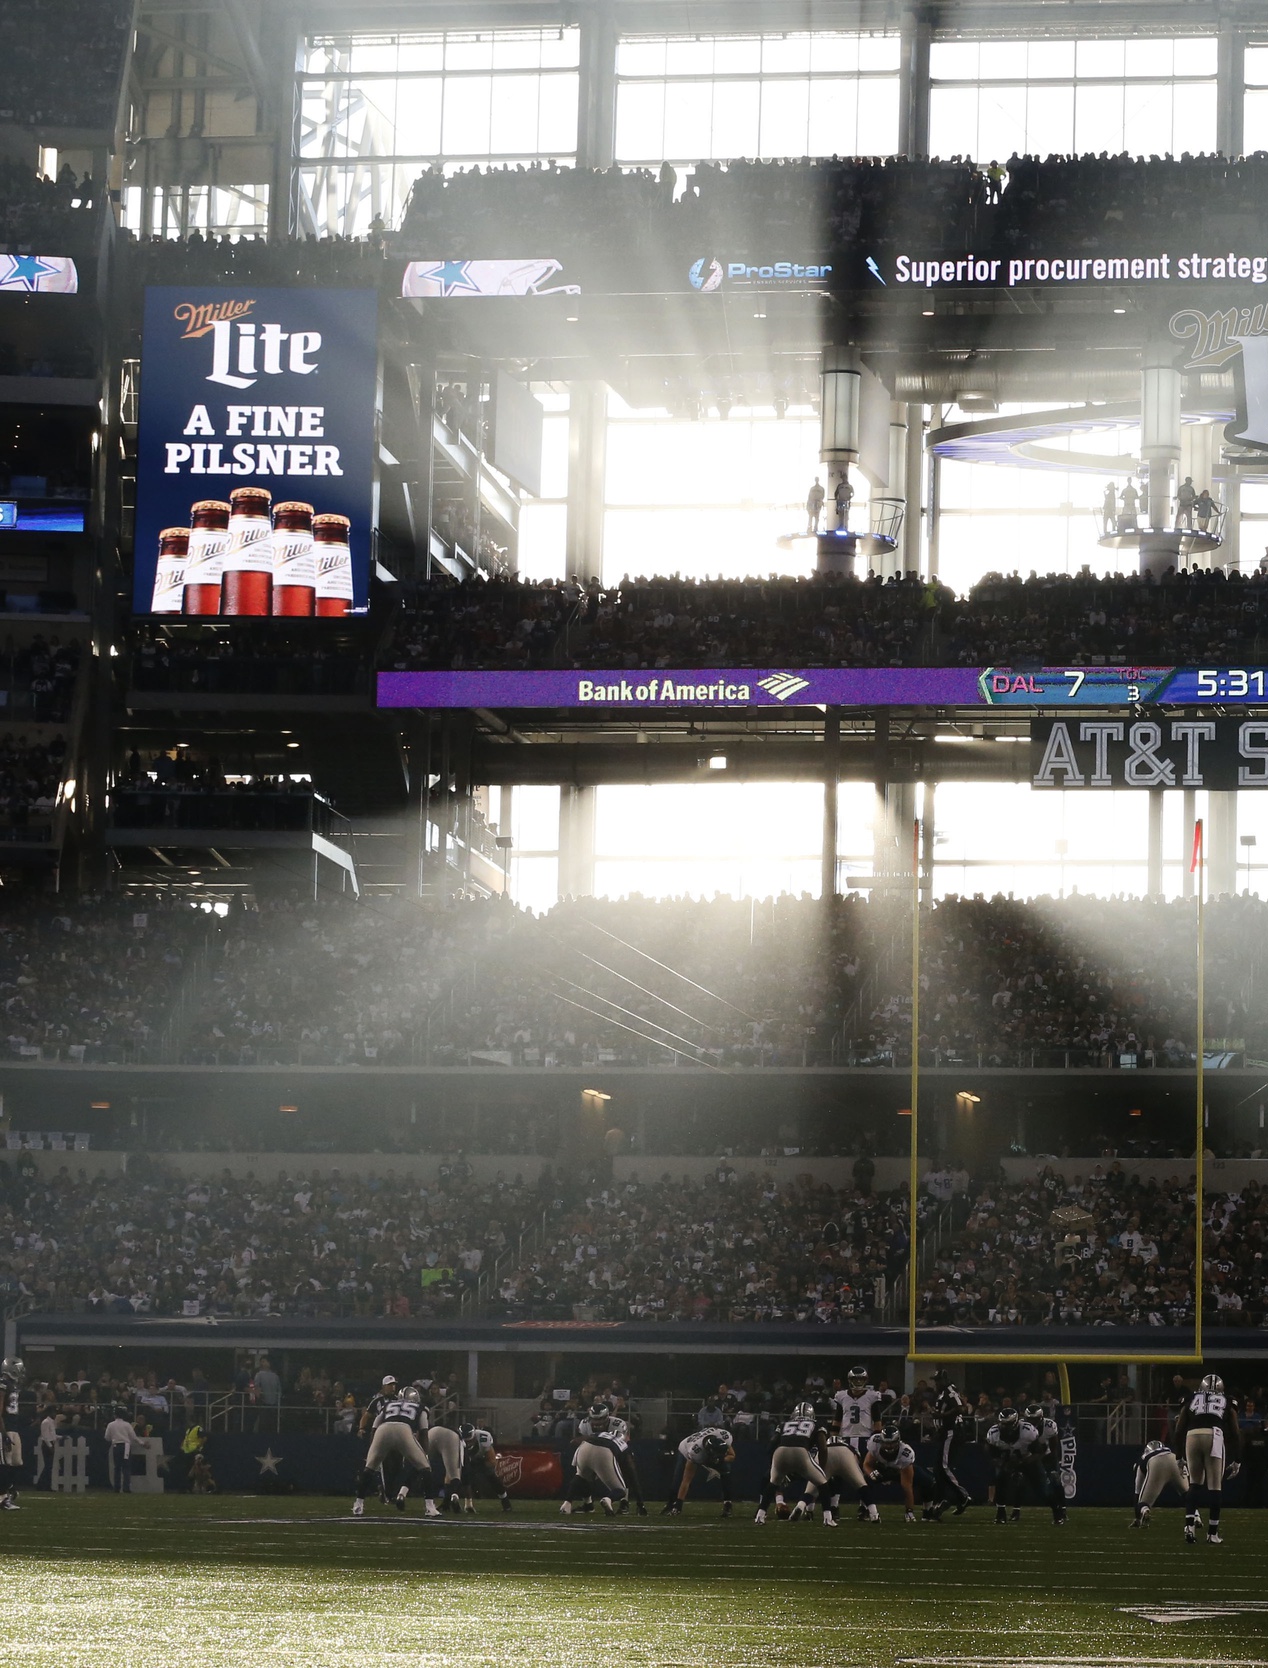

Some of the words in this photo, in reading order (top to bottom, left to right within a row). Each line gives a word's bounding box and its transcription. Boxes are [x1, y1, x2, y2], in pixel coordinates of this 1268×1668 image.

[727, 262, 832, 278] ProStar
[896, 255, 1000, 286] Superior
[1010, 254, 1170, 285] procurement
[174, 299, 257, 339] Miller
[205, 320, 322, 389] Lite
[183, 404, 215, 437] A
[226, 406, 325, 437] FINE
[165, 443, 344, 476] PILSNER
[579, 681, 633, 700] Bank
[636, 680, 658, 700] of
[660, 680, 749, 700] America
[992, 675, 1043, 693] DAL
[1064, 671, 1085, 697] 7
[1127, 685, 1140, 701] 3
[1197, 670, 1265, 697] 5:31
[1033, 721, 1216, 787] AT&T
[384, 1402, 420, 1421] 55
[849, 1405, 861, 1425] 3
[1189, 1392, 1228, 1418] 42
[782, 1420, 816, 1438] 59
